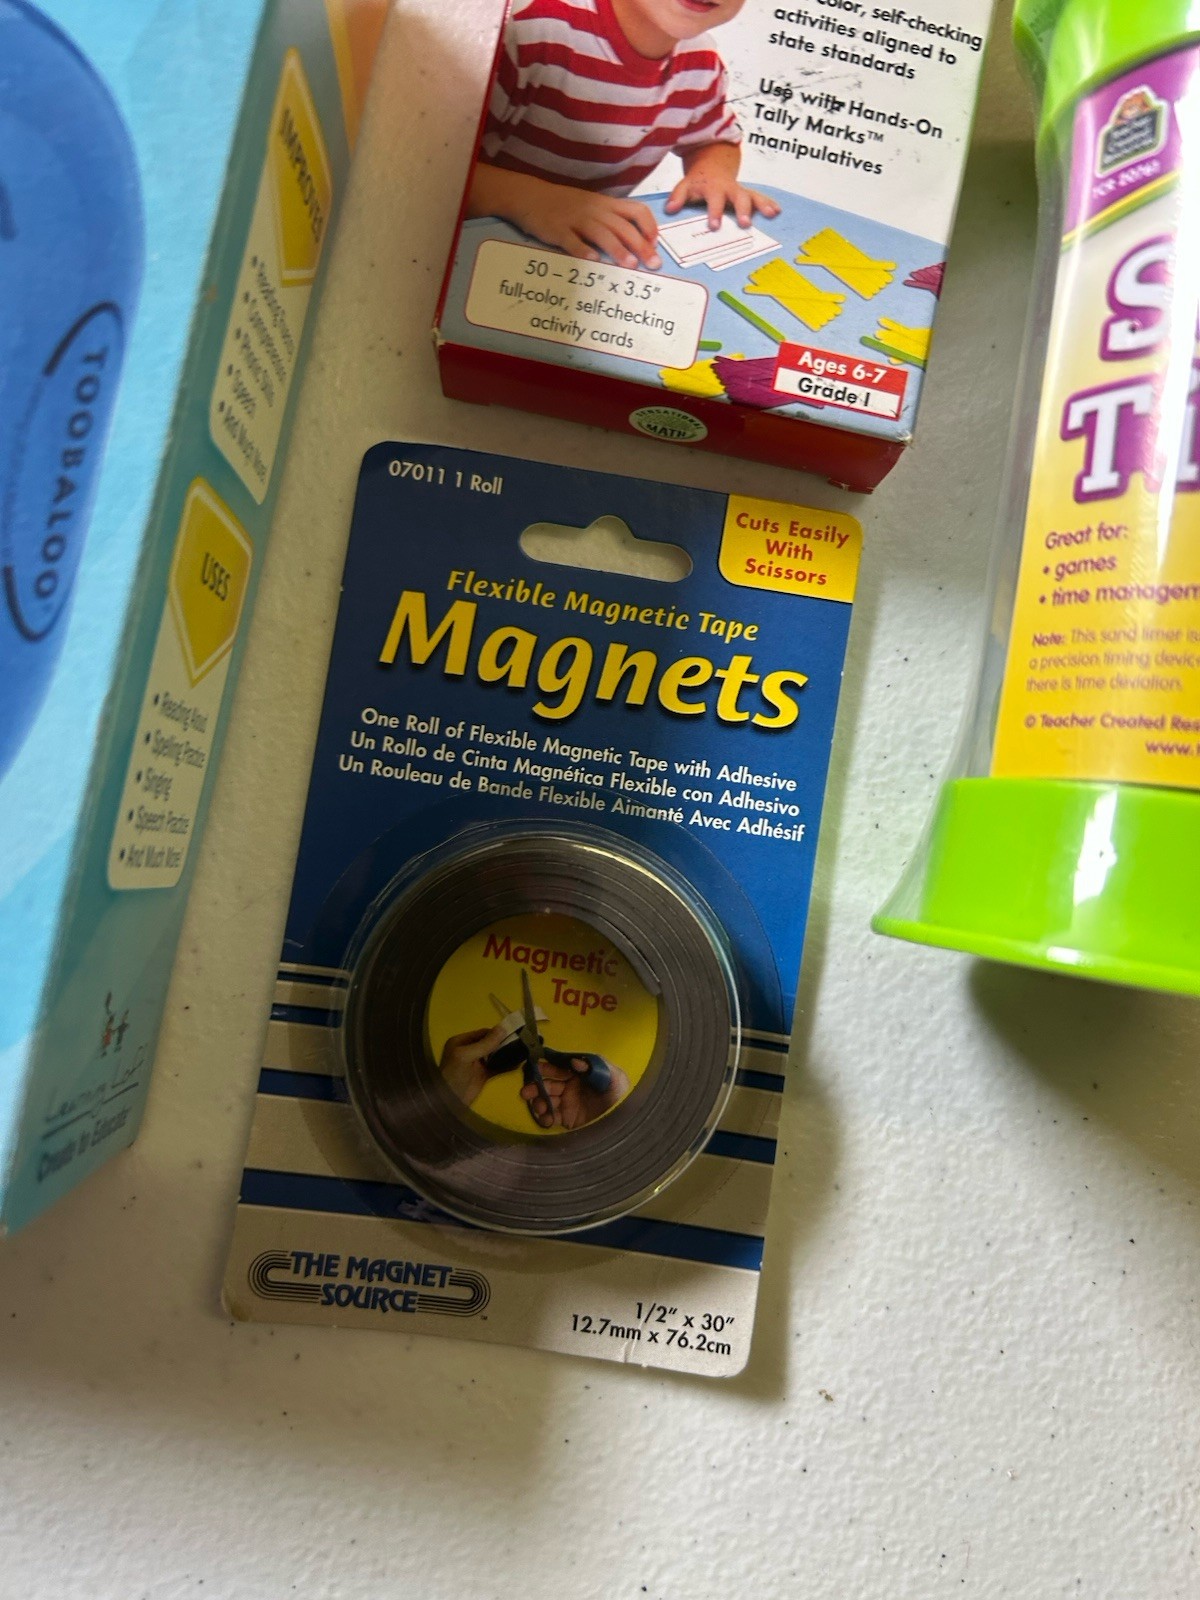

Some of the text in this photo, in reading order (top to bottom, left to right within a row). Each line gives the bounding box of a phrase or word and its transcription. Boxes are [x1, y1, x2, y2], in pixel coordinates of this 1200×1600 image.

[774, 7, 957, 65] activities aligned to
[872, 8, 982, 51] self-checking
[768, 31, 915, 79] state standards
[754, 103, 800, 130] Tally
[760, 78, 943, 138] Use with Hands-On
[748, 131, 882, 175] manipulatives
[525, 259, 548, 277] 50
[609, 281, 619, 293] x
[499, 280, 675, 336] full-color, self-checking
[530, 315, 634, 348] activity cards
[797, 351, 887, 384] Ages 6-7
[798, 377, 858, 405] Grade
[646, 423, 687, 438] MATH
[33, 345, 109, 600] TOOBALOO
[388, 459, 503, 495] 07011 1 Roll
[735, 512, 850, 548] Cuts Easily
[1045, 521, 1129, 550] Great for:
[765, 537, 814, 562] With
[201, 552, 230, 602] USES
[744, 558, 828, 587] Scissors
[1054, 554, 1117, 582] games
[447, 570, 759, 643] Flexible Magnetic Tape
[1051, 586, 1090, 606] time
[1032, 632, 1065, 647] Note:
[1101, 626, 1137, 642] sand
[379, 589, 809, 729] Magnets
[1040, 652, 1099, 671] precision
[1104, 651, 1150, 669] timing
[1027, 676, 1058, 691] there
[1061, 676, 1071, 690] is
[1076, 675, 1106, 690] time
[1041, 713, 1095, 728] Teacher
[1100, 711, 1165, 730] Created
[361, 707, 797, 792] One Roll of Flexible Magnetic Tape with Adhesive
[351, 730, 800, 818] Un Rollo de Cinta Magnética Flexible con Adhesivo
[338, 754, 806, 842] Un Rouleau de Bande Flexible Aimanté Avec Adhésif
[482, 933, 619, 977] Magnetic
[551, 978, 618, 1016] Tape
[290, 1250, 452, 1288] THE MAGNET
[320, 1283, 419, 1313] SOURCE
[571, 1313, 731, 1356] 12.7mm x 76.2cm
[682, 1315, 695, 1328] x
